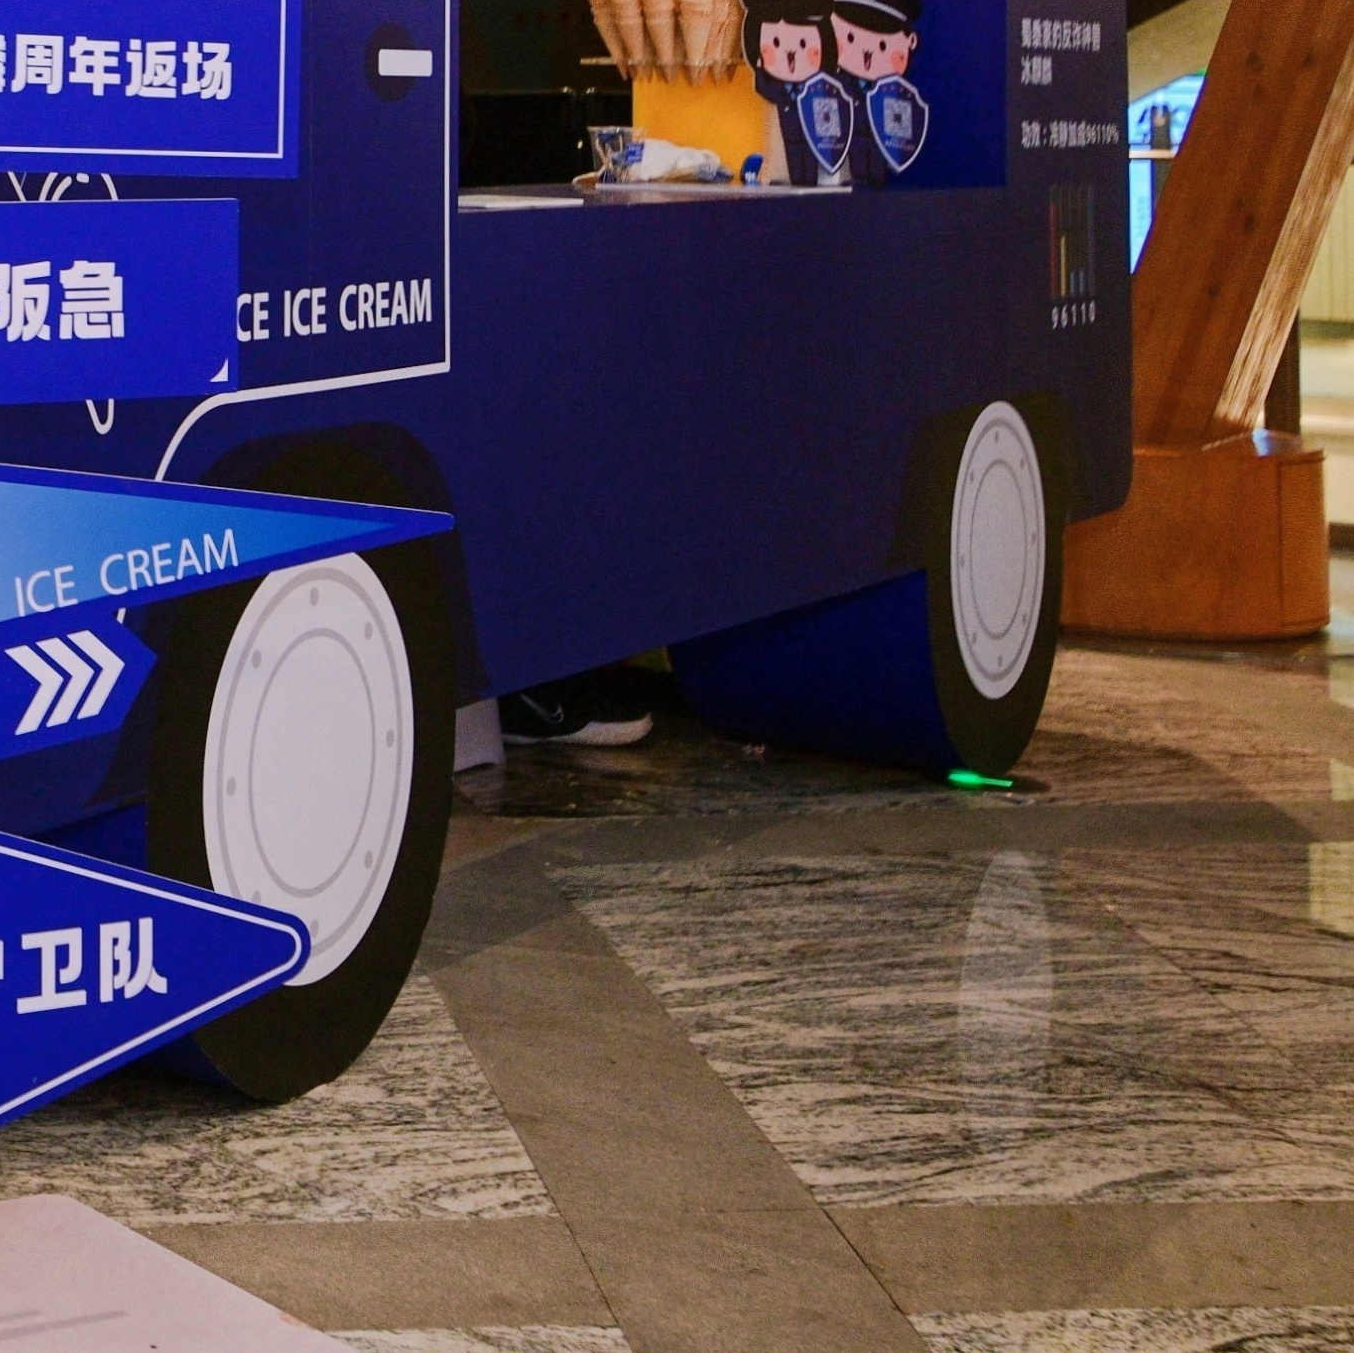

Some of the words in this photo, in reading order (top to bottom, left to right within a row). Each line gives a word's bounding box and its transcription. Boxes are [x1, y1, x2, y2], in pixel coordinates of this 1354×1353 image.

[282, 284, 328, 338] ICE
[339, 278, 433, 334] CREAM
[1051, 299, 1096, 331] 96110
[15, 565, 79, 619] ICE
[99, 528, 239, 597] CREAM
